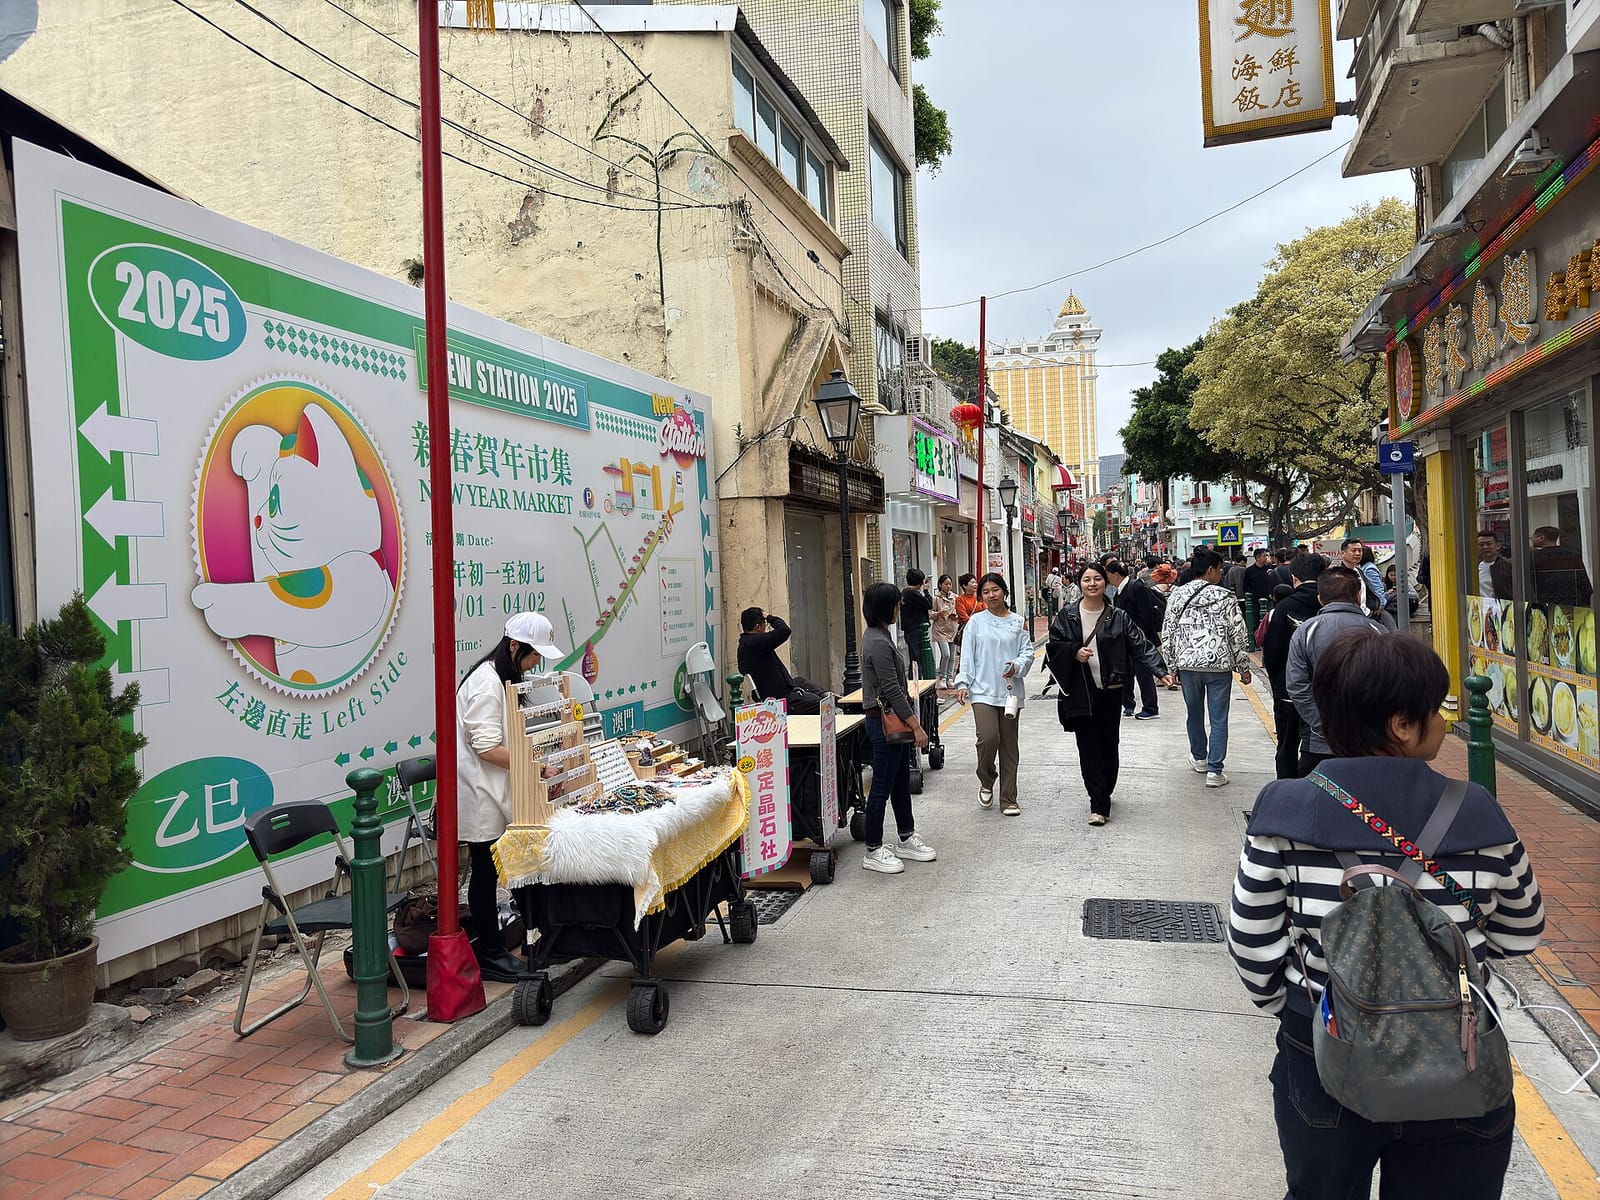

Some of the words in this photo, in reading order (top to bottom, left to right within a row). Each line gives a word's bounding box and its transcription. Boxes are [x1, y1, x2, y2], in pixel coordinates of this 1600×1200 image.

[1231, 44, 1301, 81] 海鮮
[1231, 78, 1304, 113] 飯店
[115, 260, 231, 343] 2025
[476, 359, 541, 408] STATION
[543, 379, 578, 417] 2025
[652, 392, 675, 416] New
[660, 417, 706, 457] Station
[418, 478, 465, 505] NW
[466, 483, 511, 512] YEAR
[512, 489, 573, 515] MARKET
[468, 532, 494, 547] Date:
[503, 591, 546, 616] 04/02
[215, 679, 313, 741] 左邊直走
[320, 697, 367, 735] Left
[369, 651, 409, 706] Side
[612, 707, 635, 735] 澳門
[741, 717, 788, 744] Station
[153, 777, 248, 848] 乙巳
[756, 748, 778, 862] 緣定晶石社
